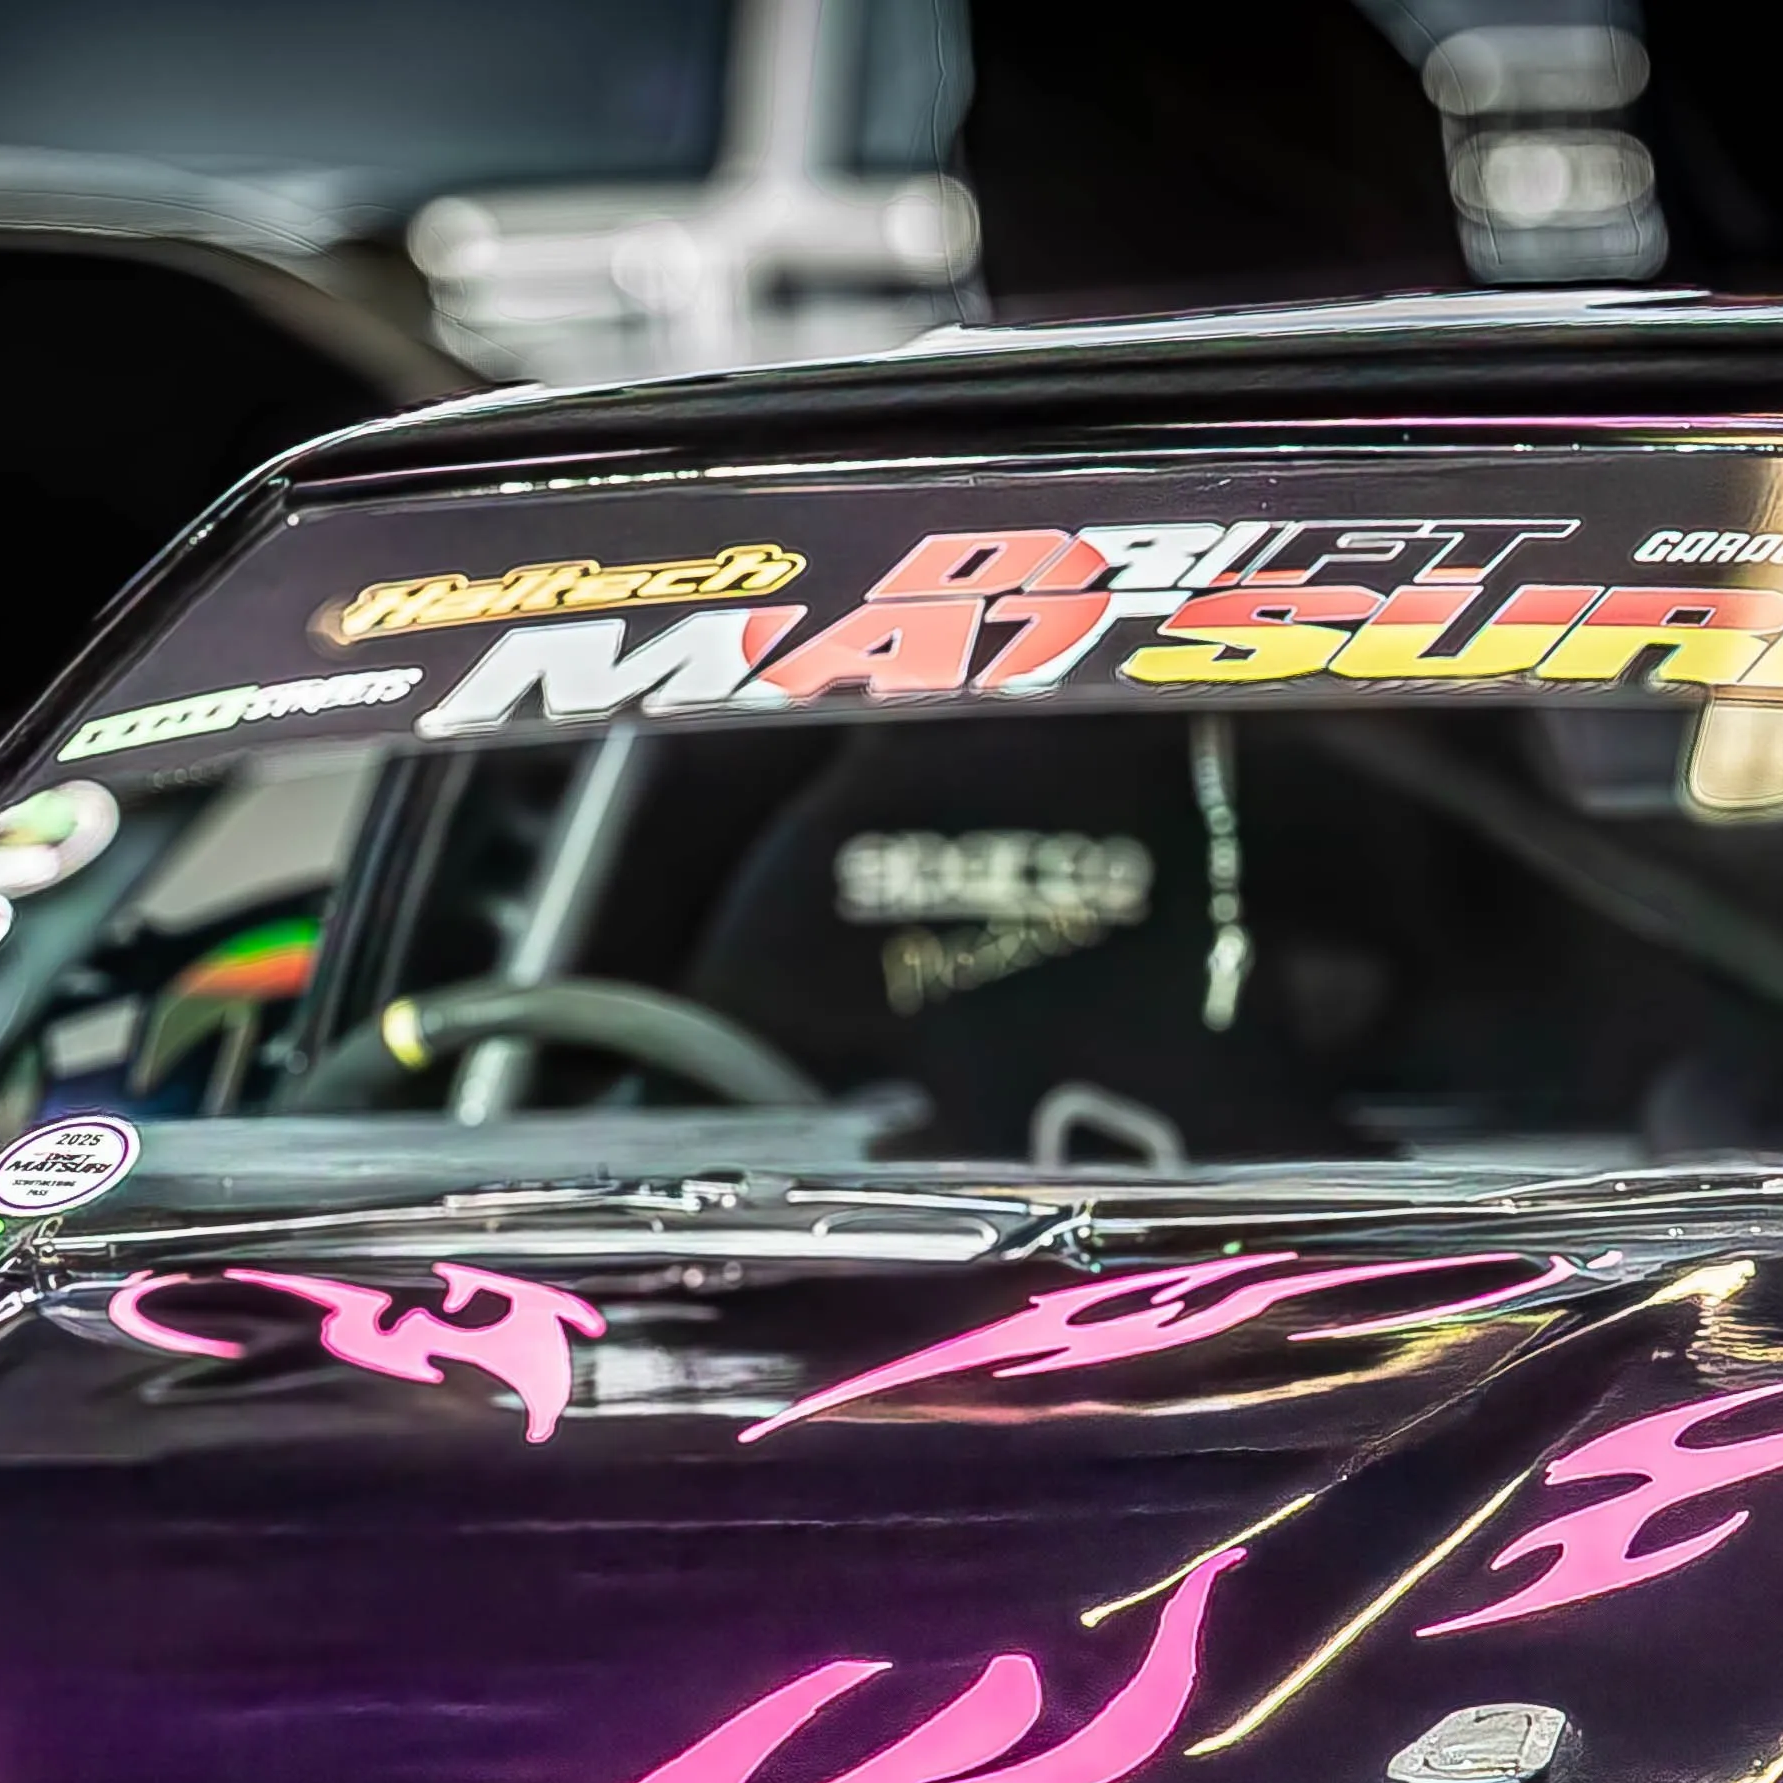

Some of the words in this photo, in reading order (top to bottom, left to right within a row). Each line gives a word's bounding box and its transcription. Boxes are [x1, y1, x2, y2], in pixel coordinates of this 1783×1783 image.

[340, 544, 808, 646] Haltech
[866, 517, 1581, 602] DRIFT
[55, 1132, 104, 1146] 2025
